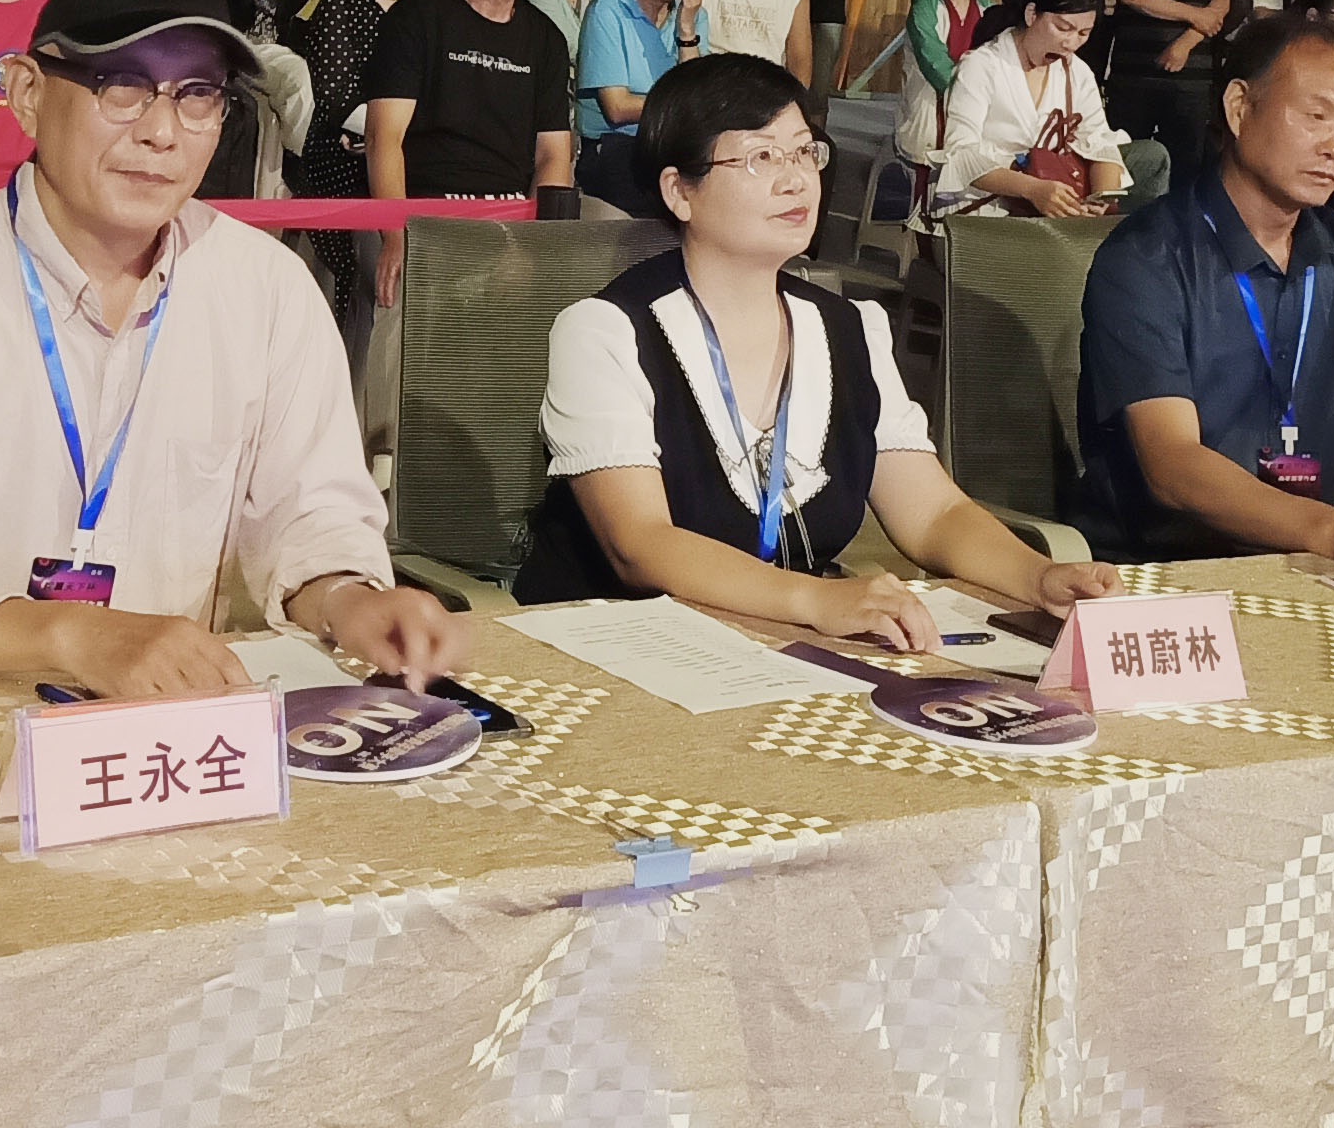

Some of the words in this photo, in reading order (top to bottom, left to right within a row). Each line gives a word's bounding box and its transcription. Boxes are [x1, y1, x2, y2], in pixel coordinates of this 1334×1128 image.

[1106, 625, 1221, 678] 胡蔚林
[286, 701, 422, 756] ON
[919, 692, 1045, 727] ON
[79, 733, 247, 811] 王永全
